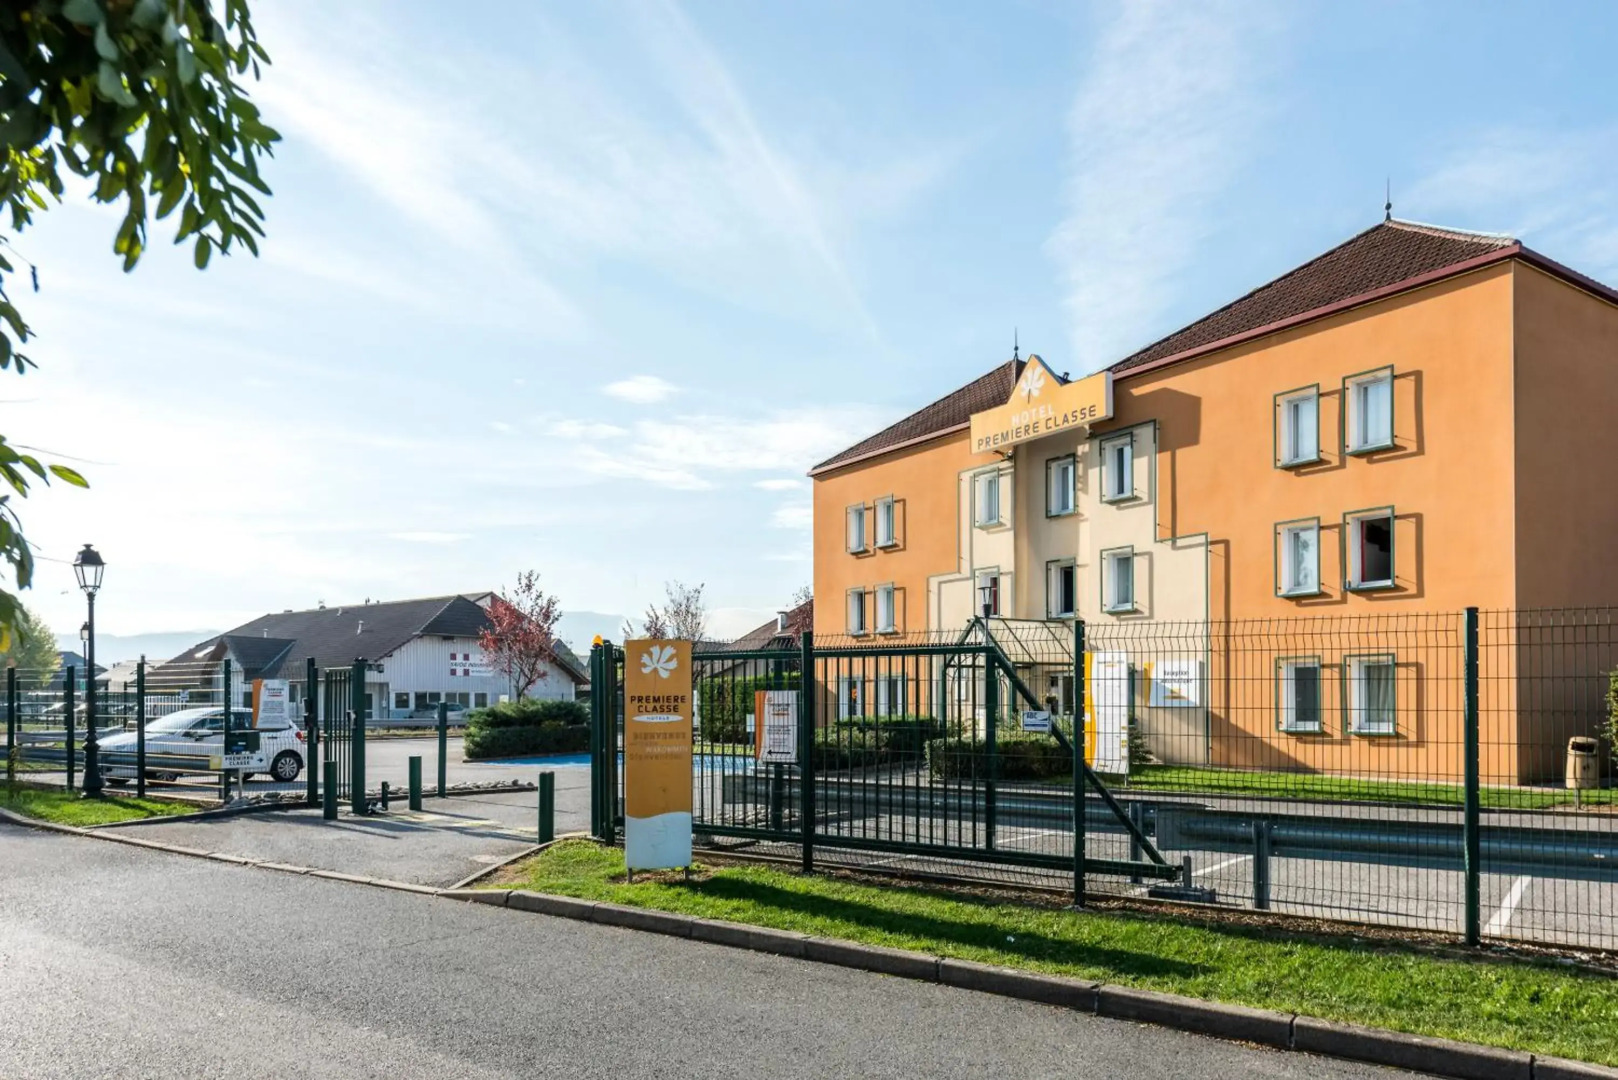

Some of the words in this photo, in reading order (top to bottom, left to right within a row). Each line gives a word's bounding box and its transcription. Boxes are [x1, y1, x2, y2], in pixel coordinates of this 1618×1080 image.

[1011, 403, 1054, 426] HOTEL
[977, 421, 1040, 450] PREMIERE
[1045, 404, 1097, 430] CLASSE
[630, 695, 686, 704] PREMIERE
[638, 704, 679, 713] CLASSE
